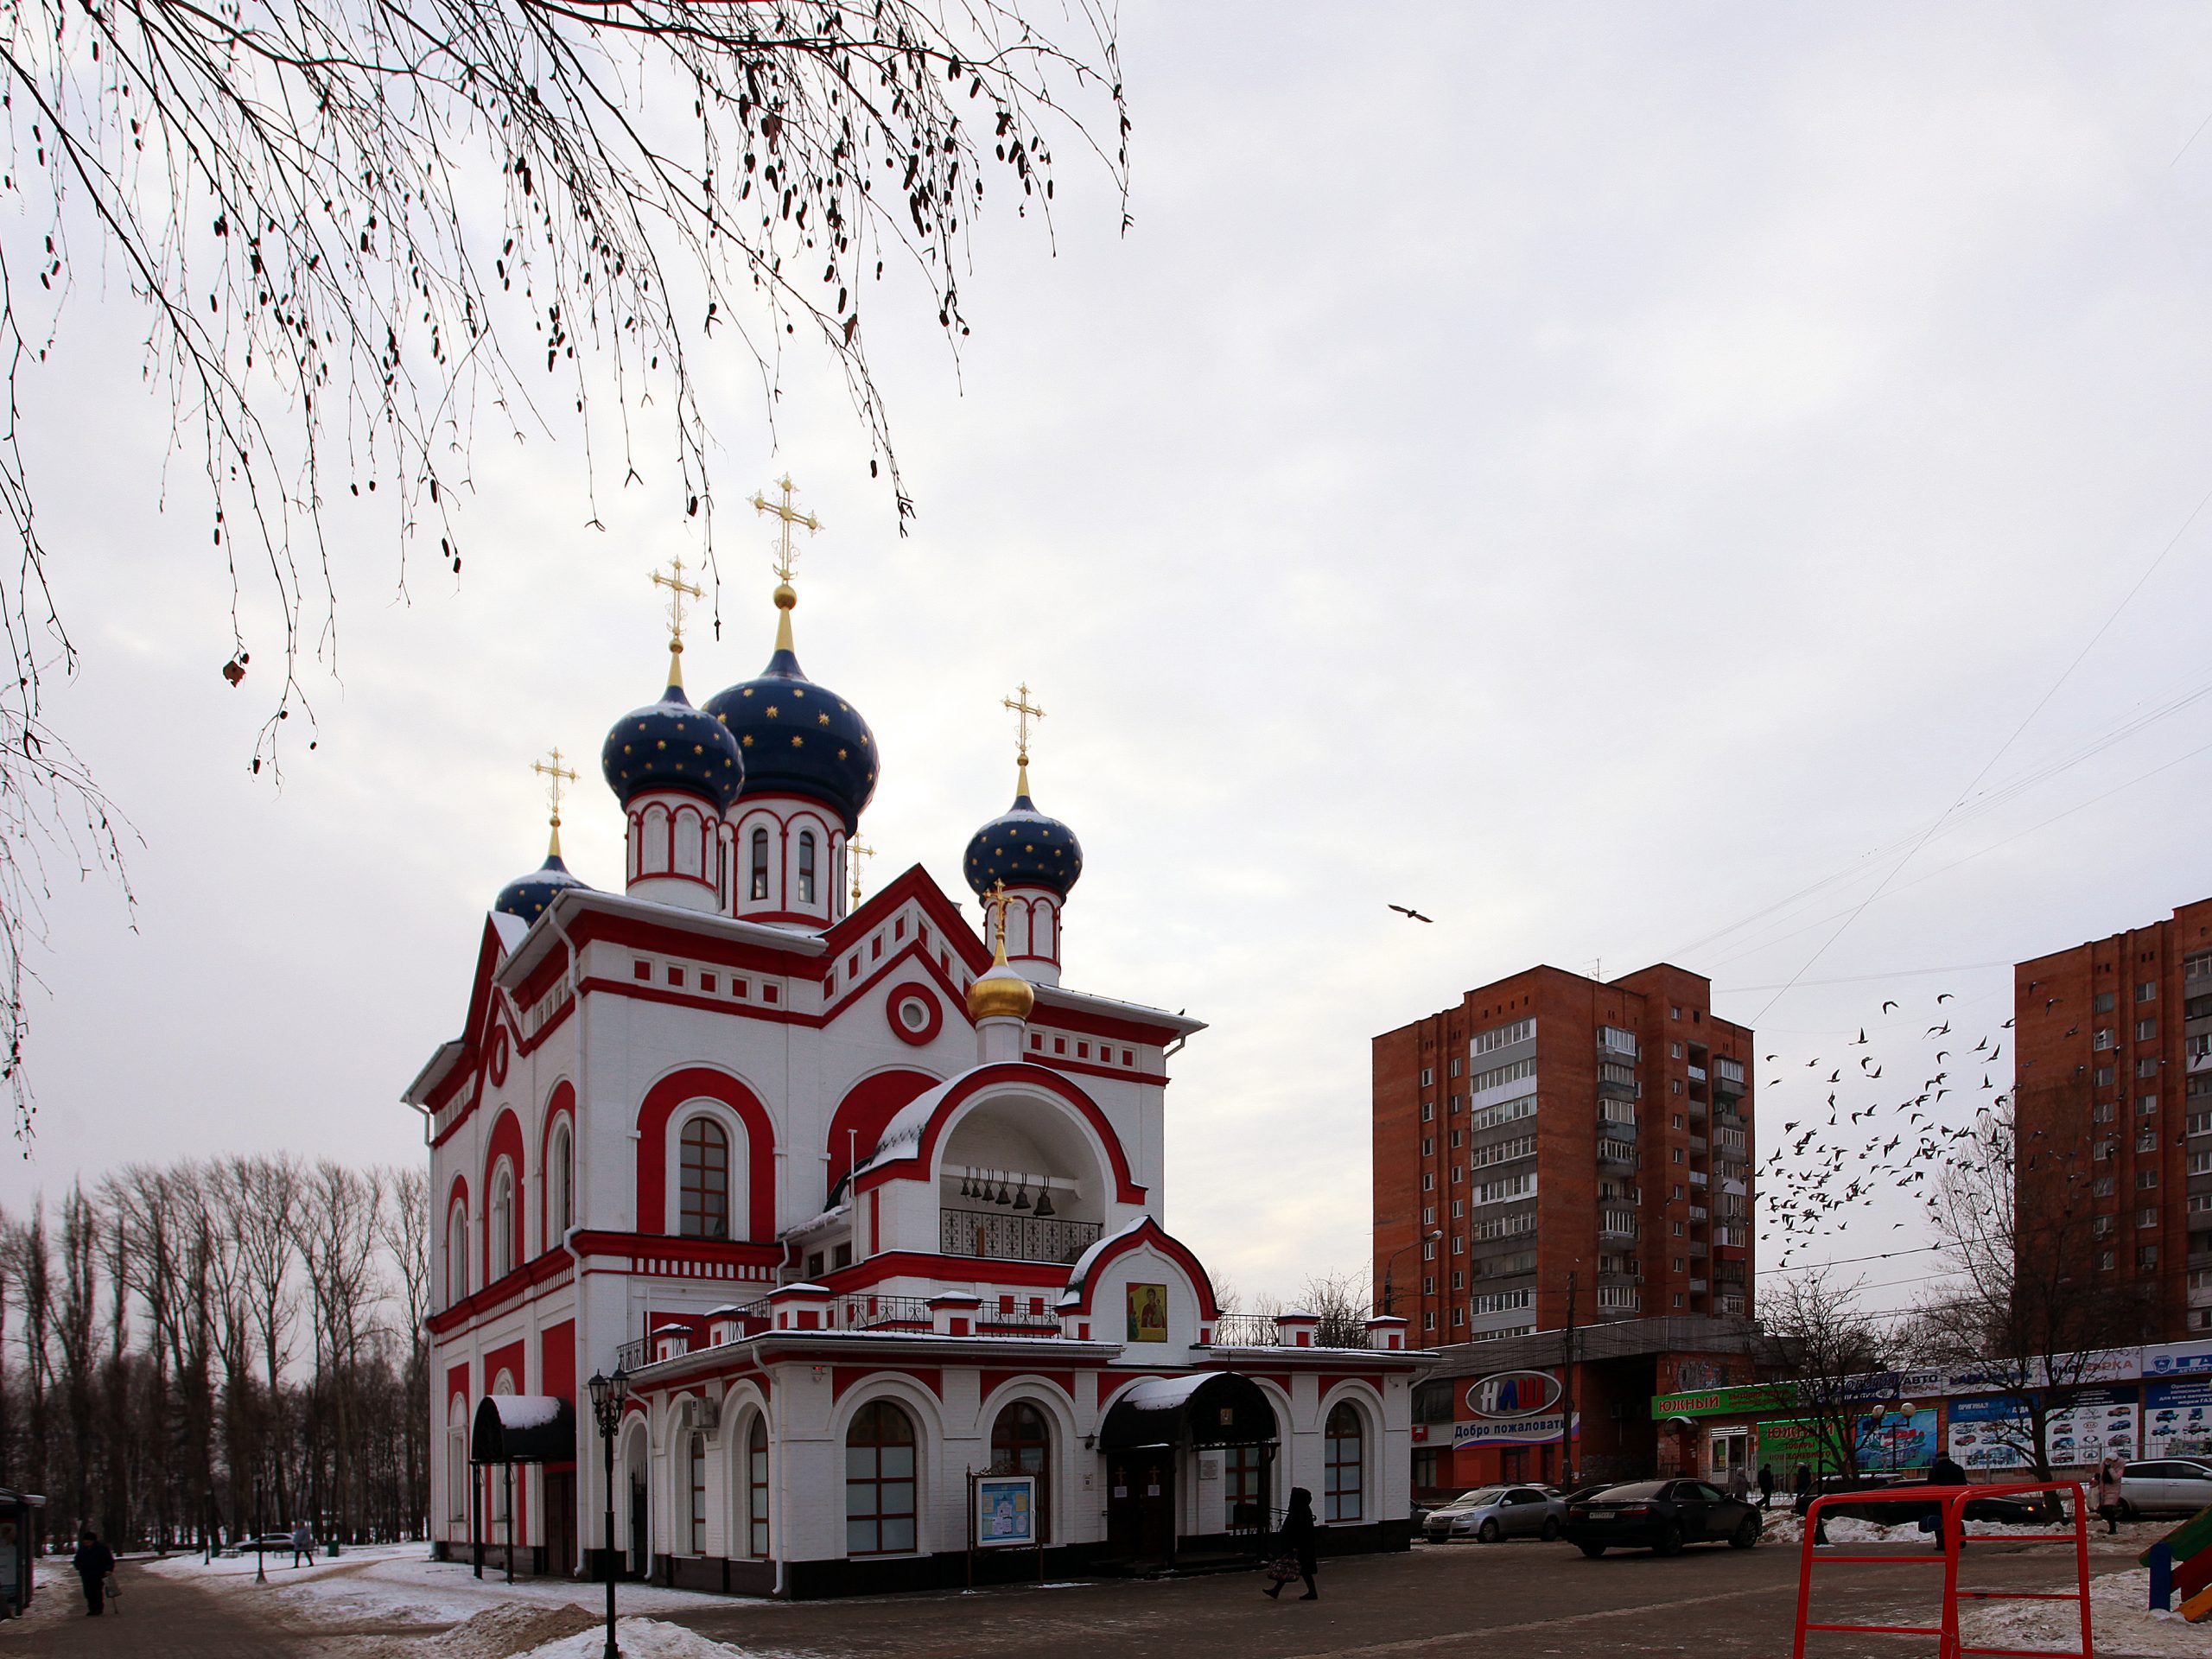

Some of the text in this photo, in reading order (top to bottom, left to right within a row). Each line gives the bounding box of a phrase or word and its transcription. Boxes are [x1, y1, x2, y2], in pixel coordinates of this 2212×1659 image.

[1904, 1375, 1937, 1385] АВТО
[1480, 1377, 1545, 1412] НАШ
[1659, 1395, 1719, 1413] ЮЖНЫЙ
[1454, 1419, 1566, 1439] Добро пожаловать
